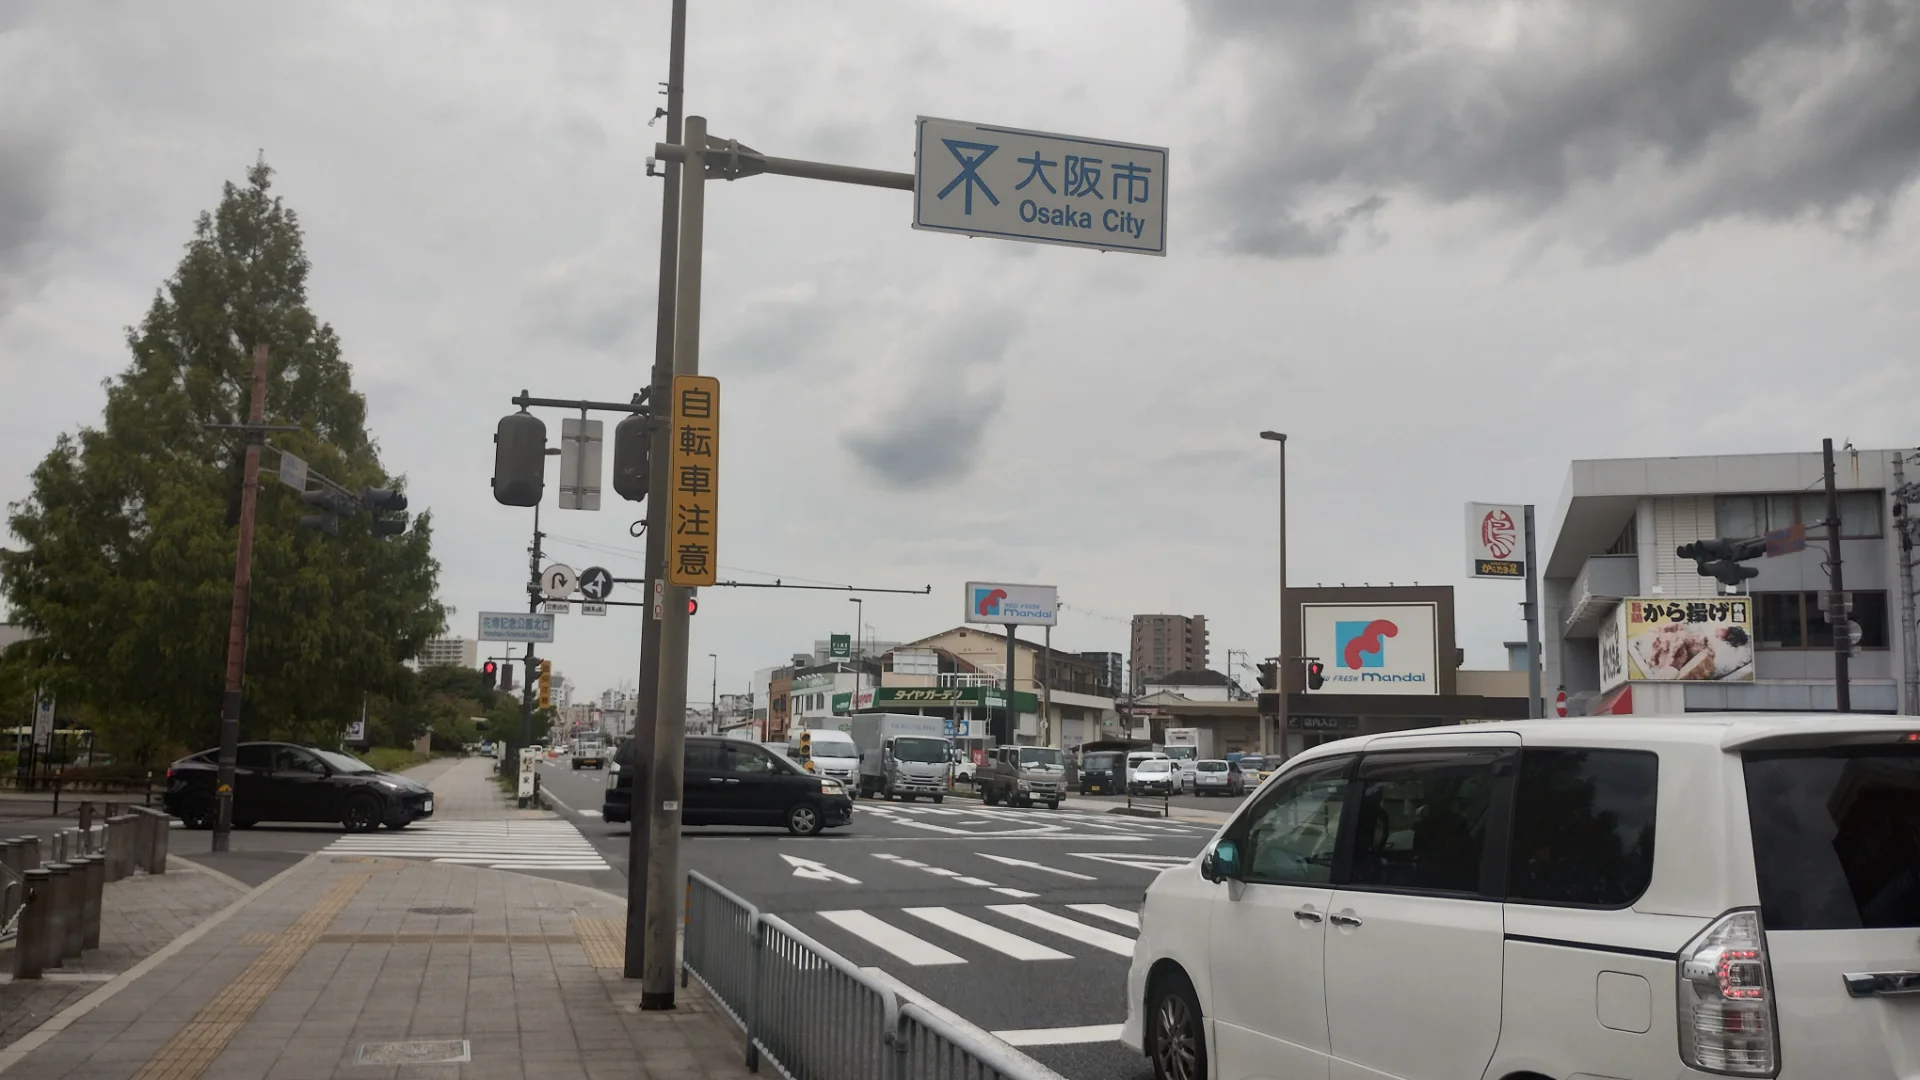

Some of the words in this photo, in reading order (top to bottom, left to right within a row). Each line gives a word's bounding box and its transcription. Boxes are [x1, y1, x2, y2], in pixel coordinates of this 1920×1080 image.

[1015, 150, 1151, 205] 大阪市
[1019, 199, 1092, 230] Osaka
[1103, 208, 1145, 239] City
[677, 387, 712, 576] 自転車注意
[1643, 602, 1730, 623] から揚げ
[1361, 672, 1425, 682] mandai
[893, 689, 964, 701] タイヤガーデン
